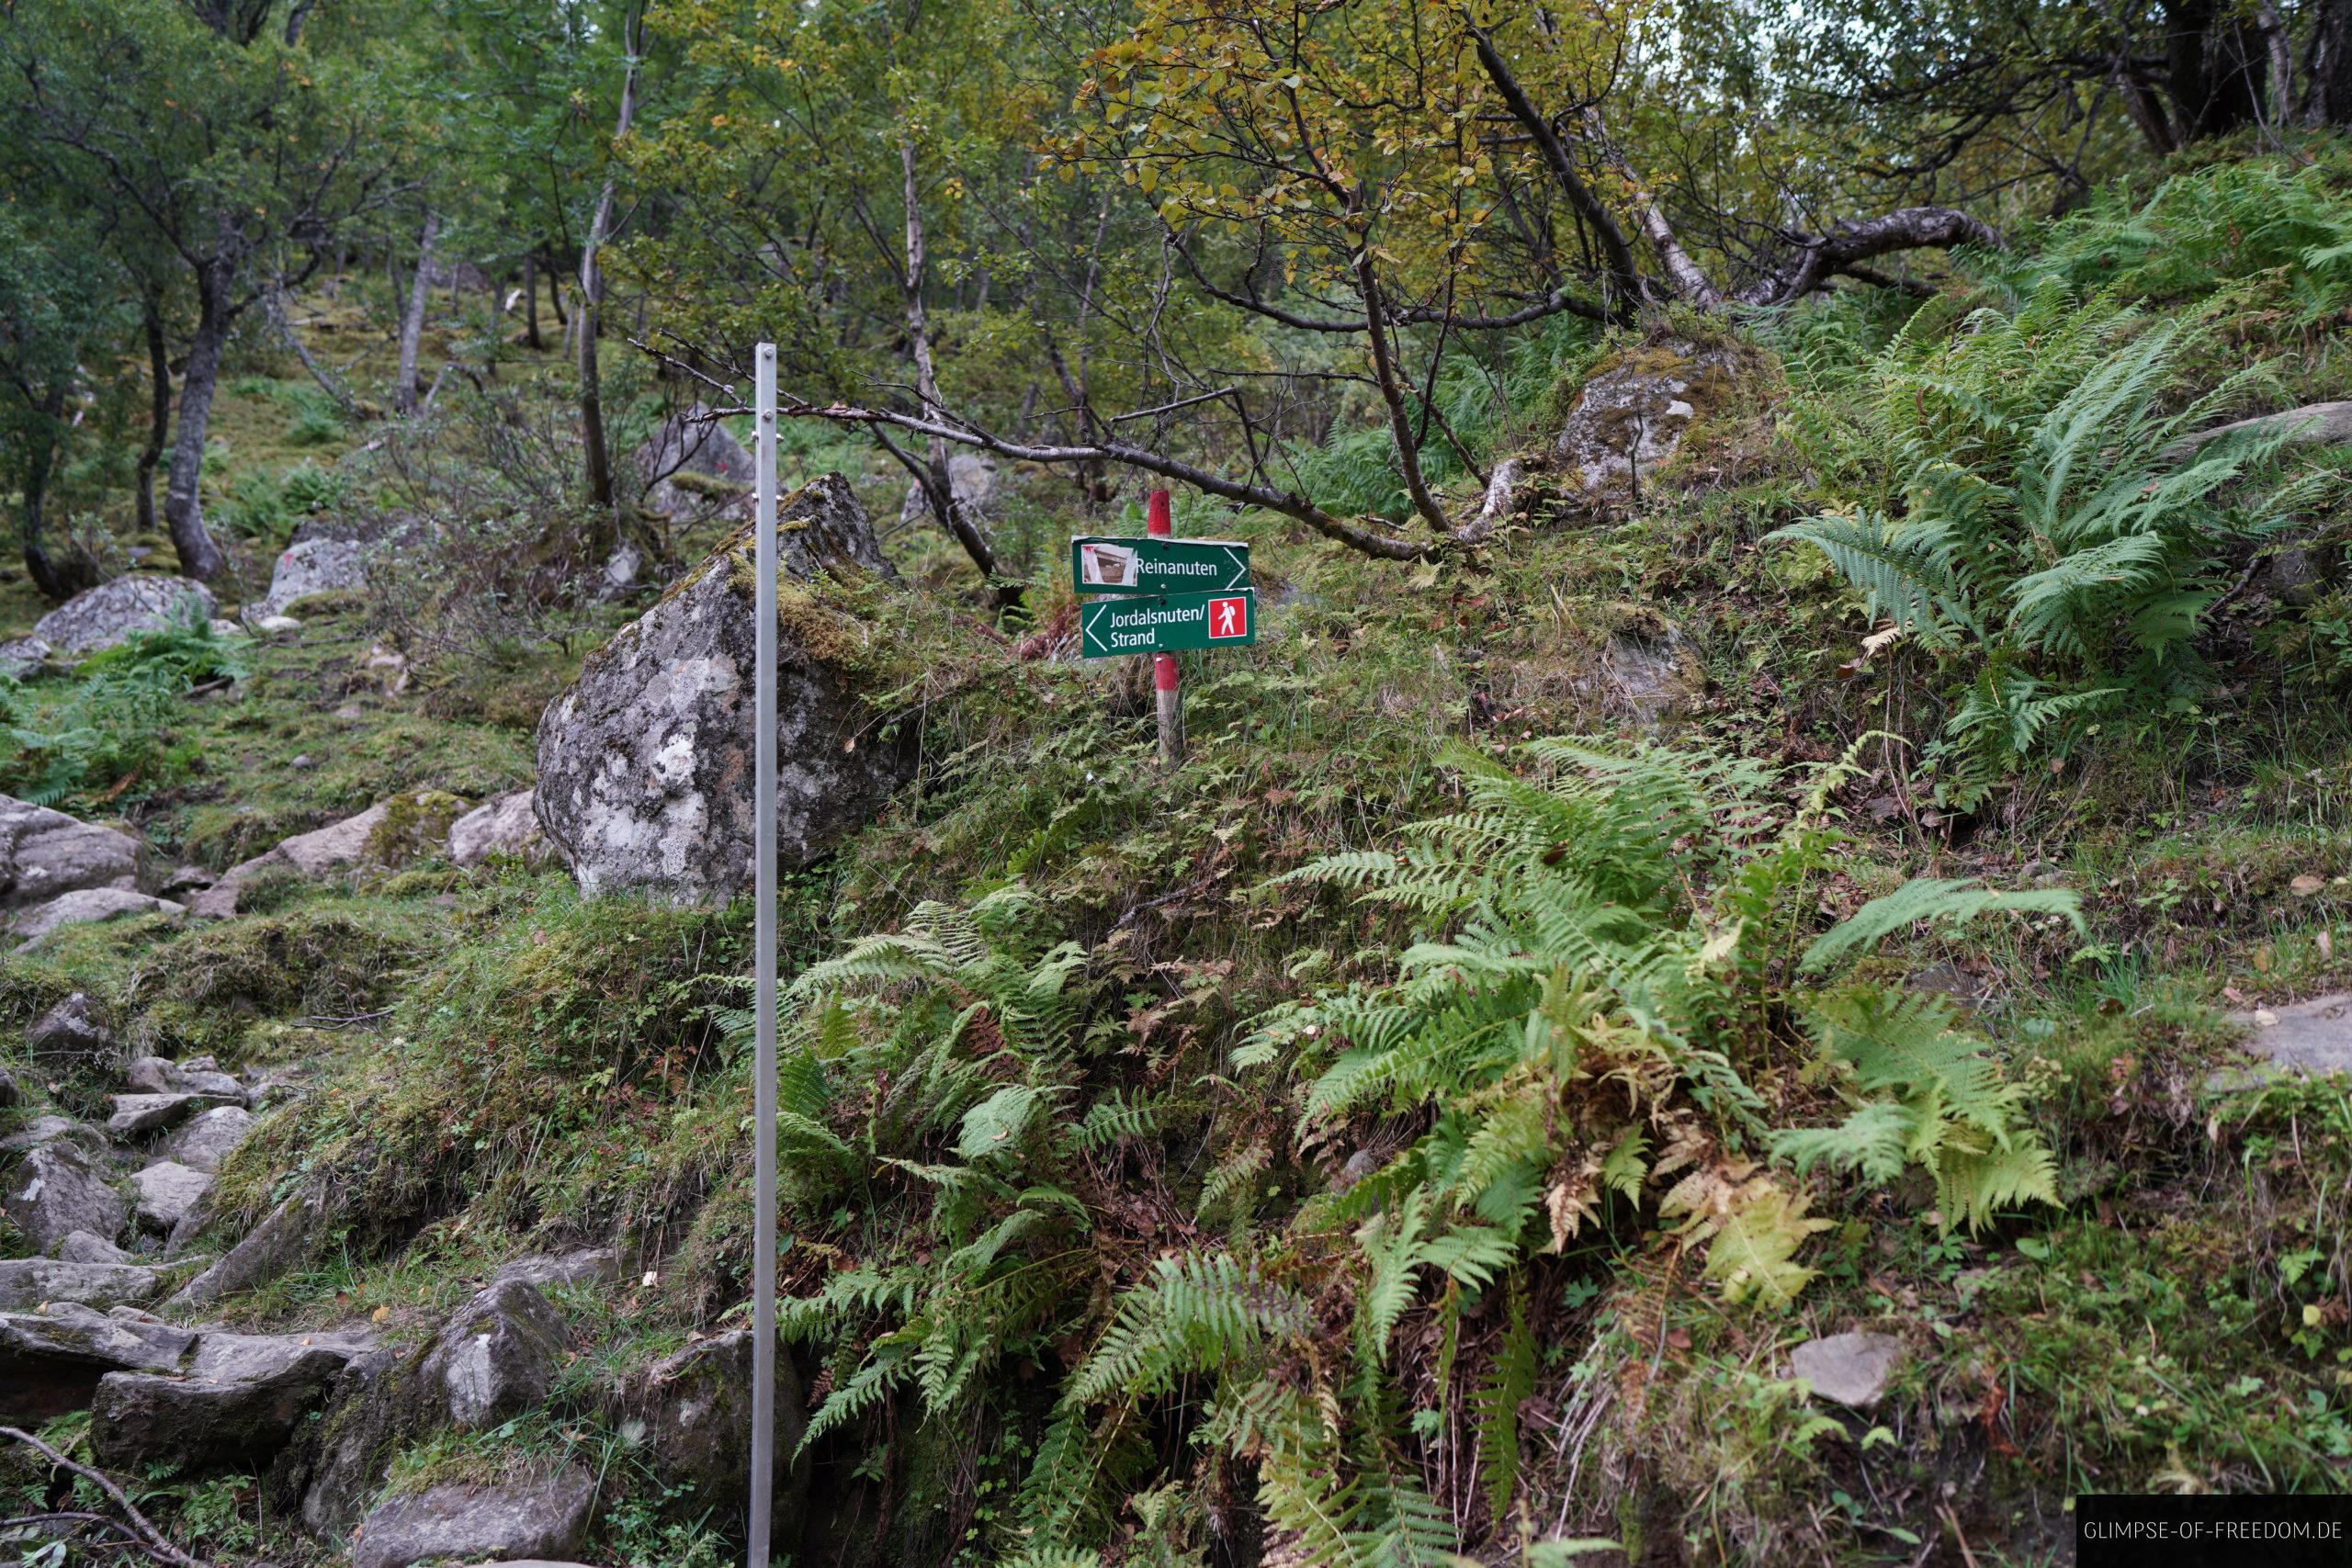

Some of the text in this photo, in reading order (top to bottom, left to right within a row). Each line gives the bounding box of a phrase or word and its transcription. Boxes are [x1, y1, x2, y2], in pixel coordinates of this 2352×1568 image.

[1136, 558, 1217, 576] Reinanuten
[1110, 604, 1204, 628] Jordalsnuten/
[1110, 627, 1155, 648] Strand
